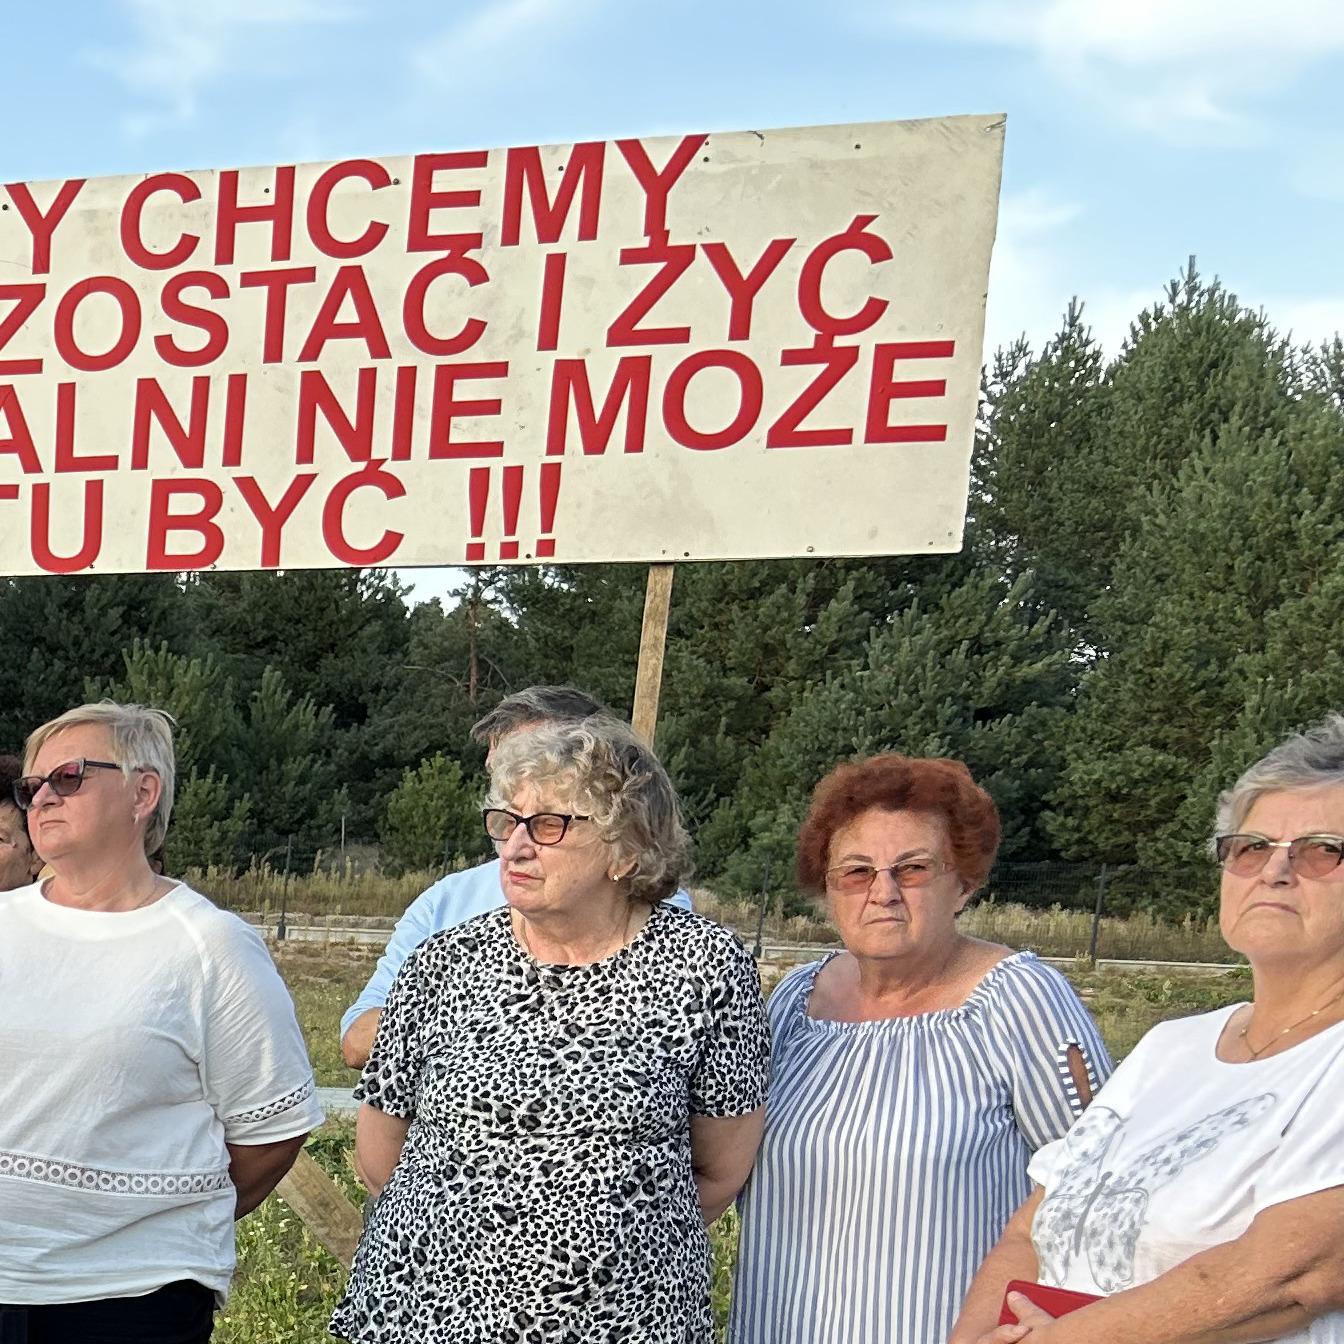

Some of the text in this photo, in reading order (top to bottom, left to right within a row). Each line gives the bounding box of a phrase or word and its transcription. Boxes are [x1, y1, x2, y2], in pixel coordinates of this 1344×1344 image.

[119, 133, 710, 272] CHCEMY
[536, 251, 568, 352] I
[606, 214, 894, 348] ŻYĆ
[295, 360, 510, 465] NIE
[545, 333, 956, 456] MOŻE
[146, 457, 407, 571] BYĆ
[464, 461, 562, 562] !!!
